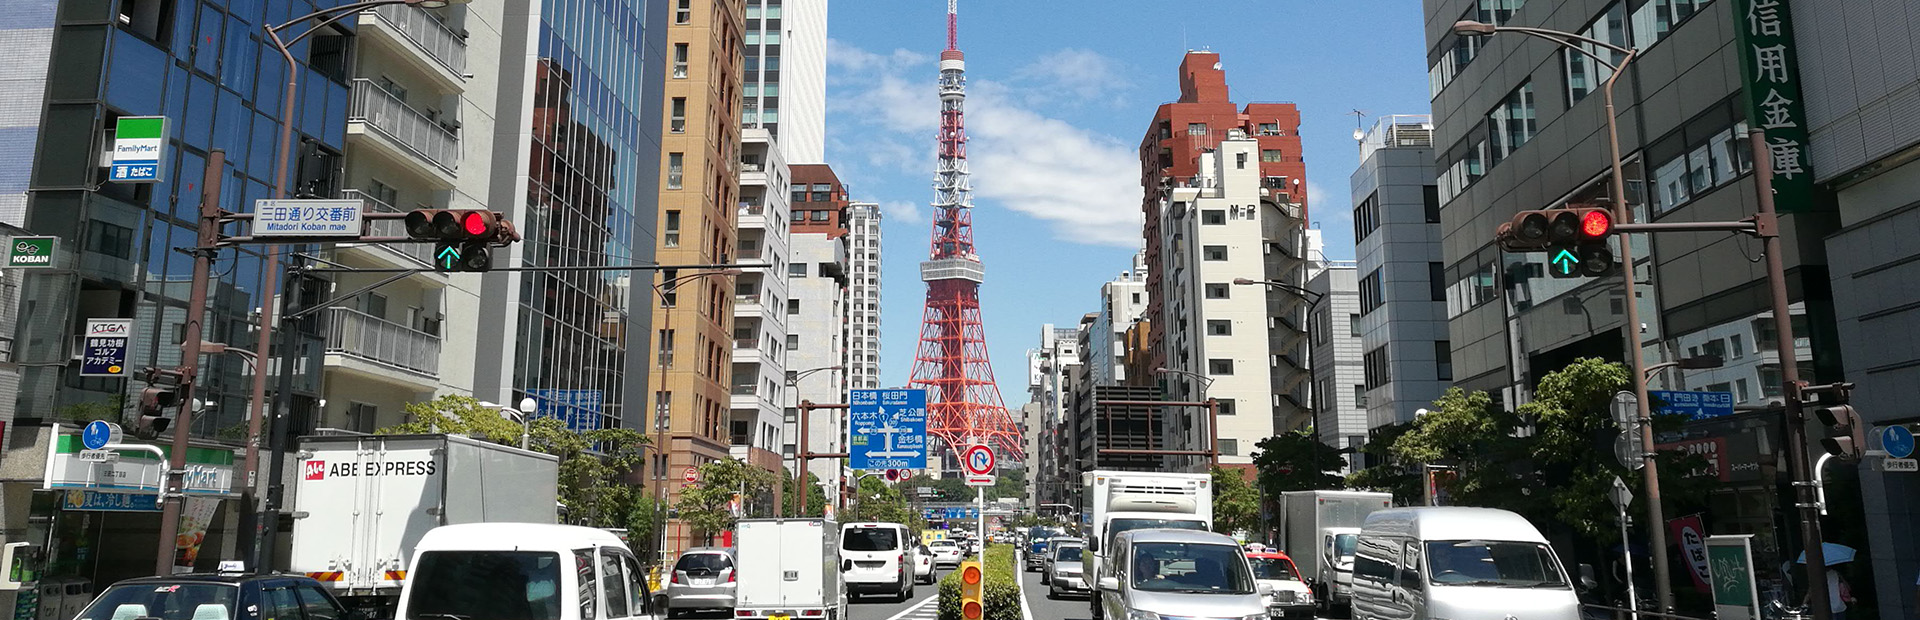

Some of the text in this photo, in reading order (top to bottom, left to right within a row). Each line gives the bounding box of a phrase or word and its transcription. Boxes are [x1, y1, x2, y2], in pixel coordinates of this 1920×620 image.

[1746, 0, 1804, 180] 信用金庫
[117, 145, 158, 154] FamilyMart
[115, 166, 153, 178] 酒 たばこ
[260, 207, 356, 222] 三田通り交番前
[266, 223, 299, 231] Mitadori
[301, 223, 326, 231] Koban
[12, 255, 49, 263] KOBAN
[92, 324, 125, 333] KTGA
[90, 339, 124, 347] 鶴見功樹
[94, 348, 117, 356] ゴルフ
[86, 357, 122, 365] アカデミー
[852, 391, 908, 400] 日本橋 桜田門
[852, 412, 878, 420] 六本木
[899, 408, 925, 417] 芝公園
[898, 435, 923, 444] 金杉橋
[81, 452, 106, 460] 歩行者優先
[329, 462, 361, 477] ABE
[365, 461, 436, 476] EXPRESS
[1887, 461, 1916, 469] 歩行者優先
[1683, 532, 1710, 579] たばこ
